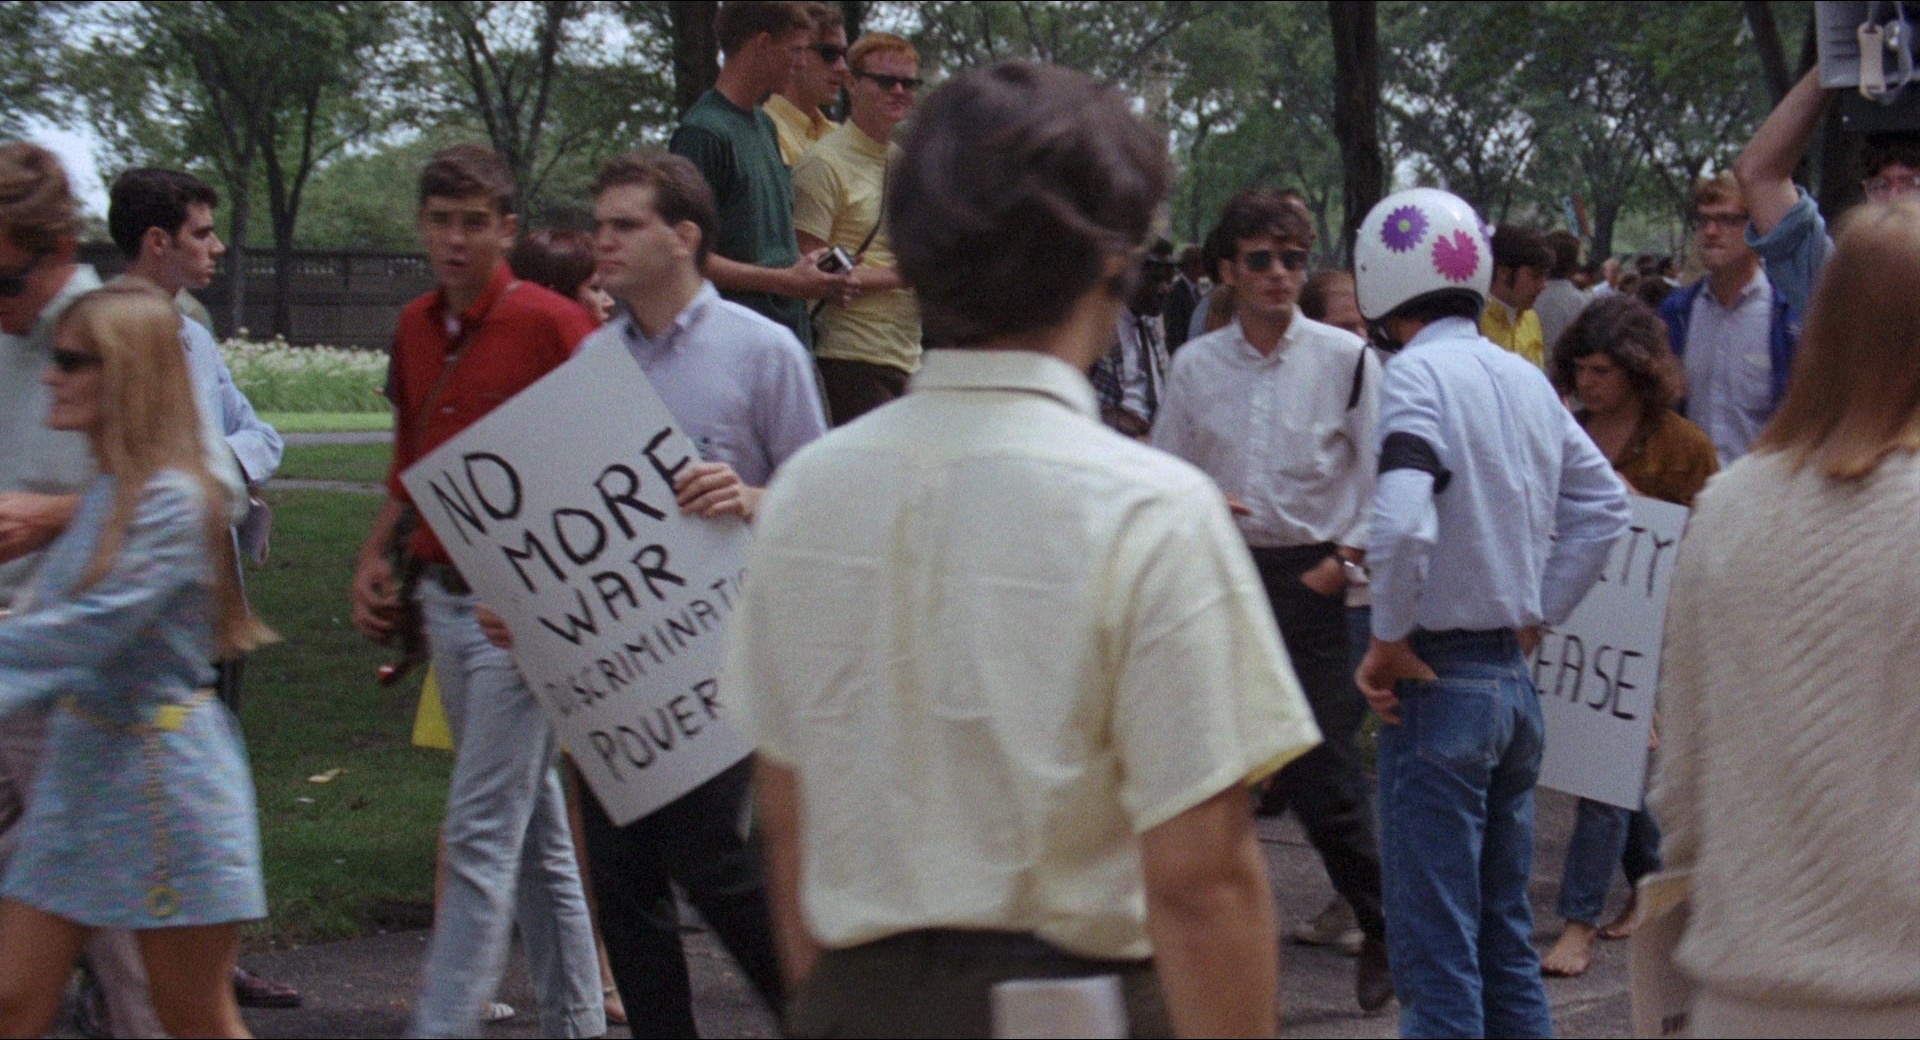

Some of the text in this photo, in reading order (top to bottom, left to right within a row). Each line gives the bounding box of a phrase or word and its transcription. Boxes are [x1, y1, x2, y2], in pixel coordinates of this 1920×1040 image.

[428, 451, 523, 547] NO
[501, 426, 690, 594] MORE
[537, 543, 687, 646] WAR
